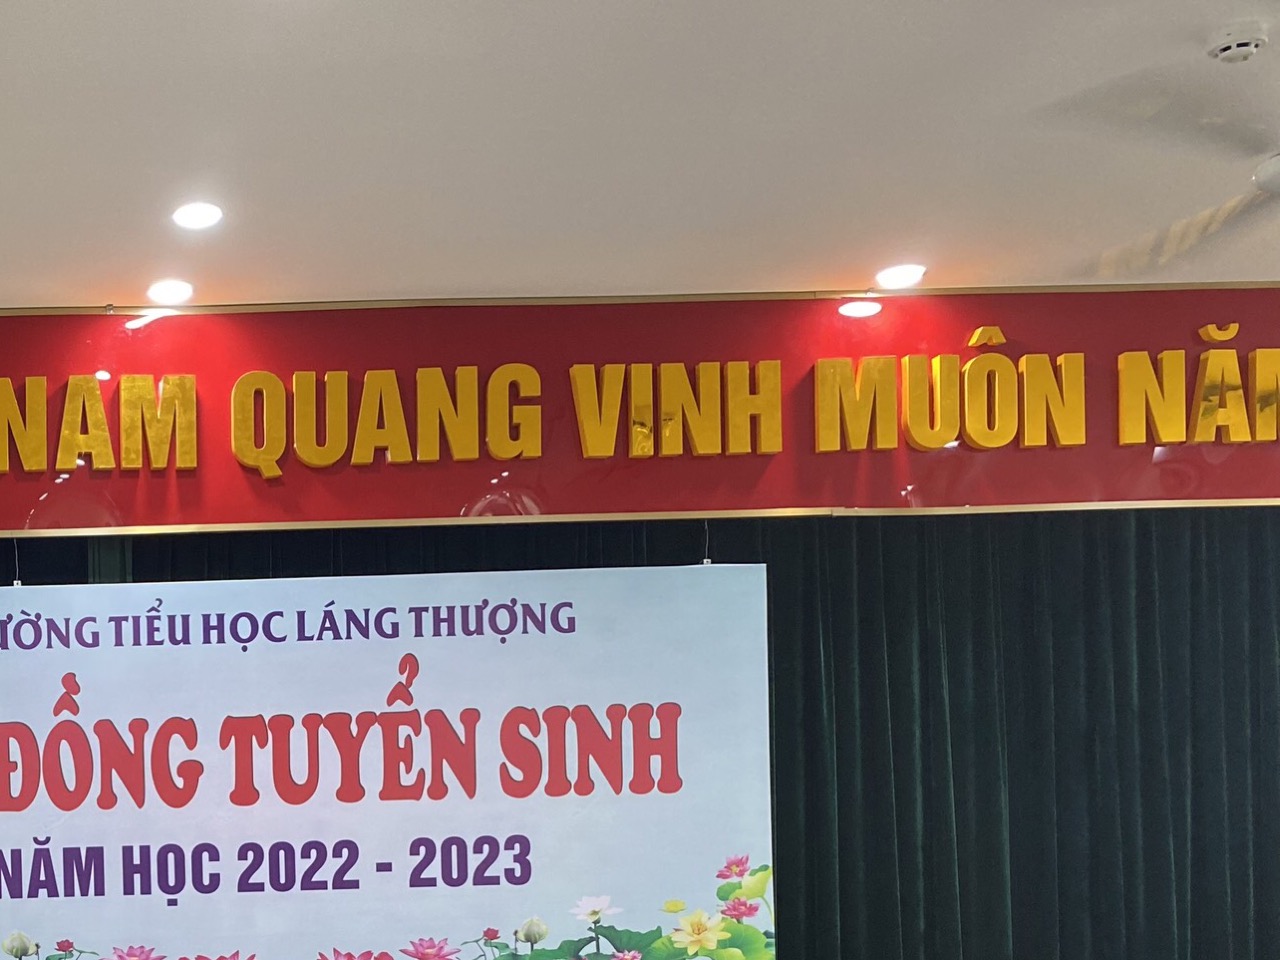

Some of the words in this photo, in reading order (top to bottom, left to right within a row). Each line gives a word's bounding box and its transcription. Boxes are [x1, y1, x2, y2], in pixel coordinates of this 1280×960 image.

[231, 363, 542, 479] QUANG
[569, 360, 782, 458] VINH
[815, 325, 1087, 453] MUÔN
[108, 598, 191, 648] TIỂU
[202, 611, 288, 652] HỌC
[296, 600, 400, 642] LÁNG
[408, 597, 577, 644] THƯỢNG
[219, 653, 481, 806] TUYỂN
[499, 702, 682, 798] SINH
[122, 842, 221, 907] HỌC
[237, 839, 360, 893] 2022
[376, 862, 393, 873] -
[409, 834, 532, 888] 2023
